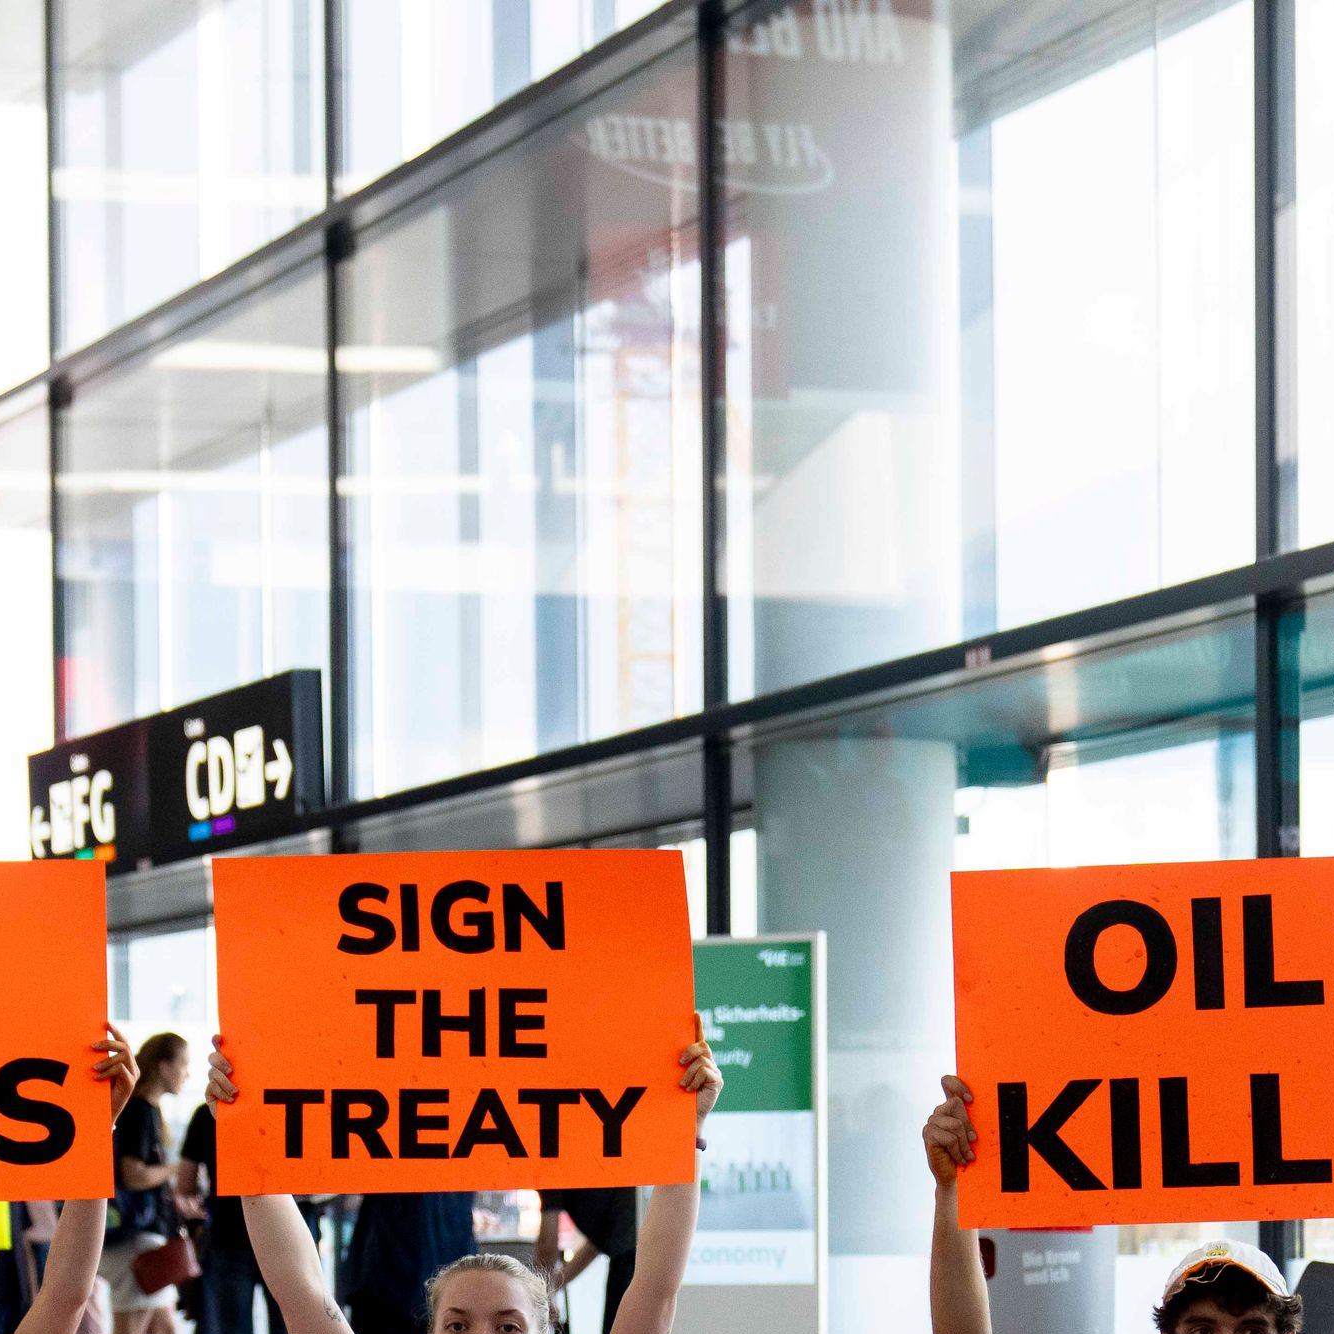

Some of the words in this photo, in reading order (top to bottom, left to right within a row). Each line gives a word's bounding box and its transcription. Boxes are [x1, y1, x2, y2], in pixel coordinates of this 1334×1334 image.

[336, 880, 566, 955] SIGN
[1064, 894, 1325, 1016] OIL
[355, 986, 548, 1058] THE
[263, 1087, 647, 1160] TREATY
[689, 1245, 787, 1270] conomy
